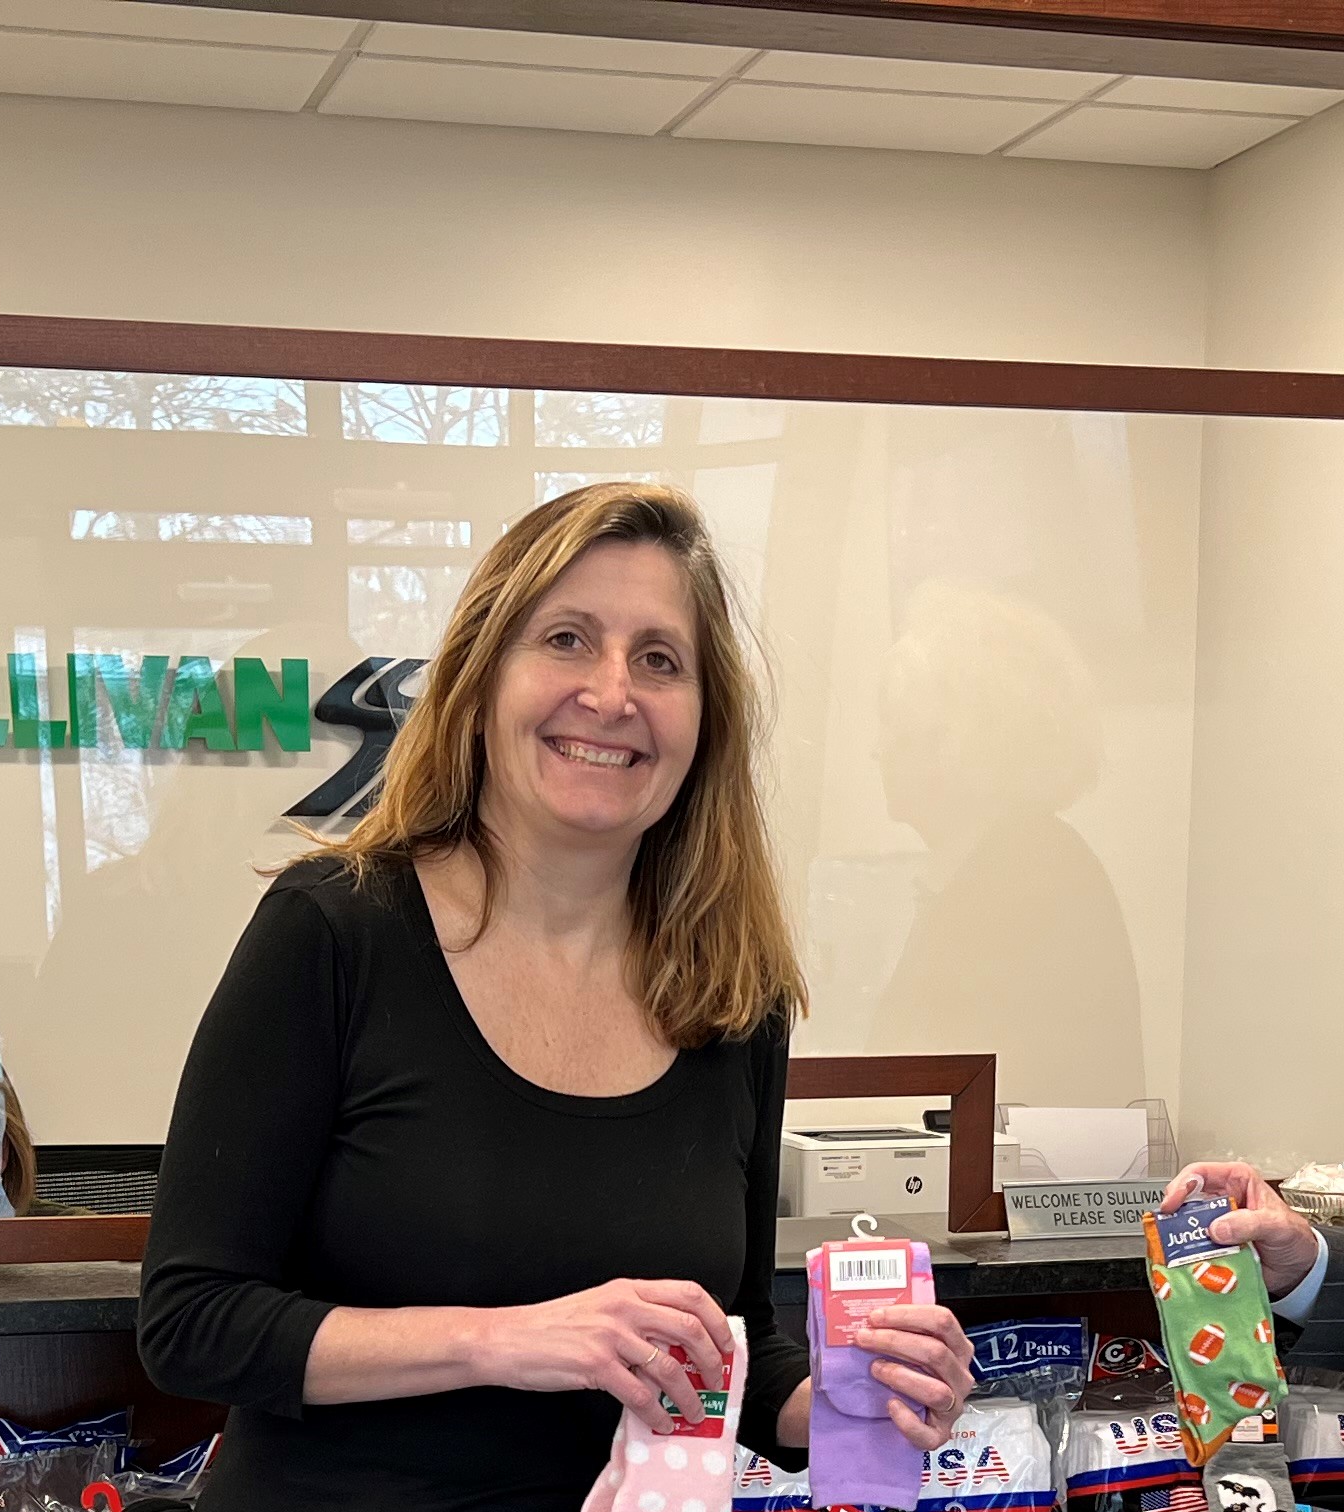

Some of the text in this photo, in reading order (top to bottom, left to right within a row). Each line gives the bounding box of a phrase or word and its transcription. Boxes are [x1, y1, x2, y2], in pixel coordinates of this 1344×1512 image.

[905, 1176, 923, 1195] hp
[1011, 1194, 1081, 1209] WELCOME
[1084, 1192, 1103, 1206] TO
[1054, 1210, 1105, 1226] PLEASE
[1167, 1227, 1207, 1247] Junct
[985, 1333, 1071, 1362] 12 Pairs
[1110, 1413, 1182, 1455] US
